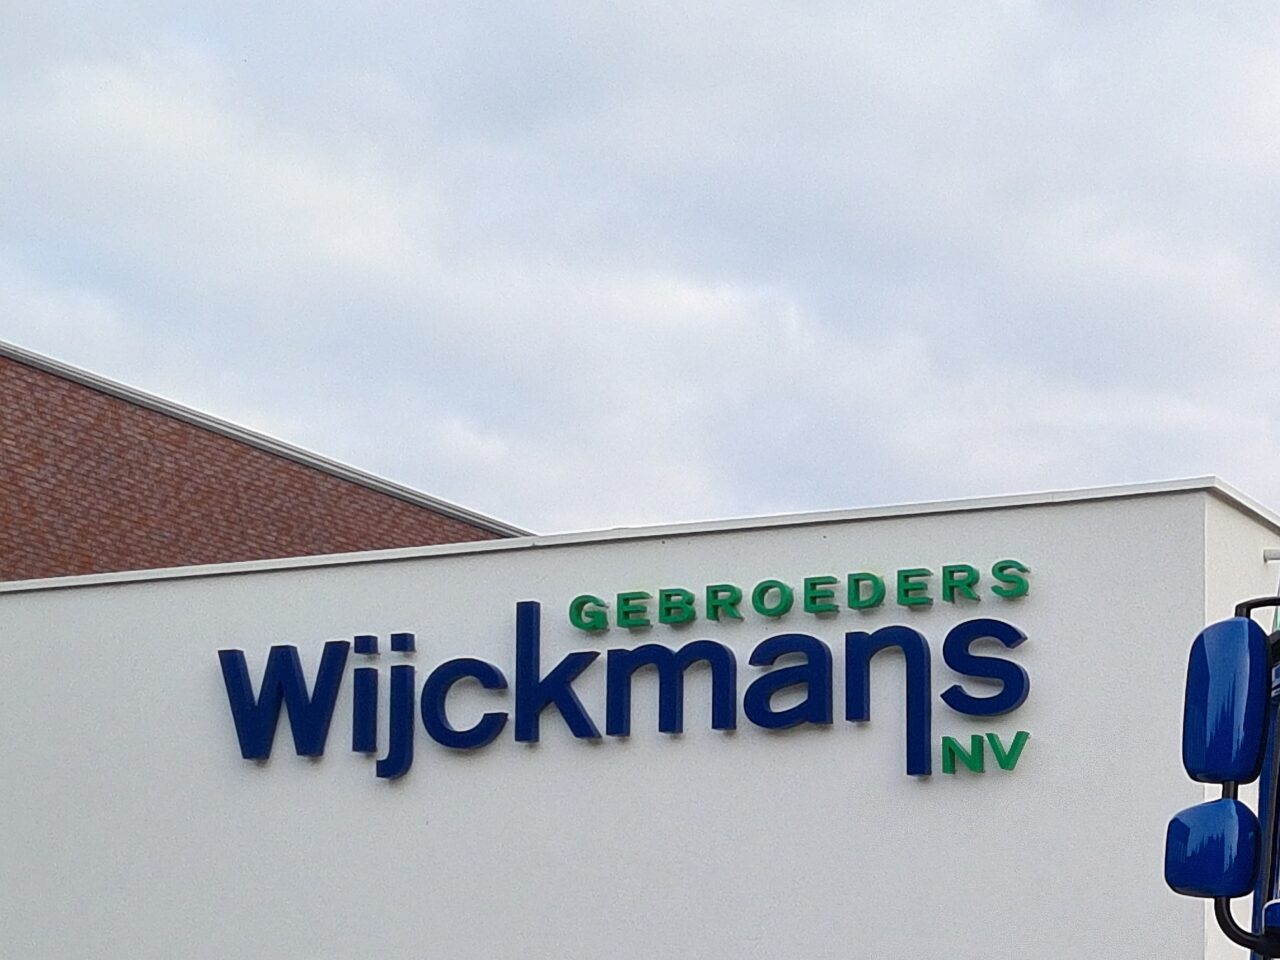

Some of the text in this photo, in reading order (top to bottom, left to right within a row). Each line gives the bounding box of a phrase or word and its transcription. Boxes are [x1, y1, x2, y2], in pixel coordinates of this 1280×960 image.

[570, 560, 1030, 632] GEBROEDERS
[218, 601, 1029, 778] Wijckmans
[942, 731, 1029, 774] NV
